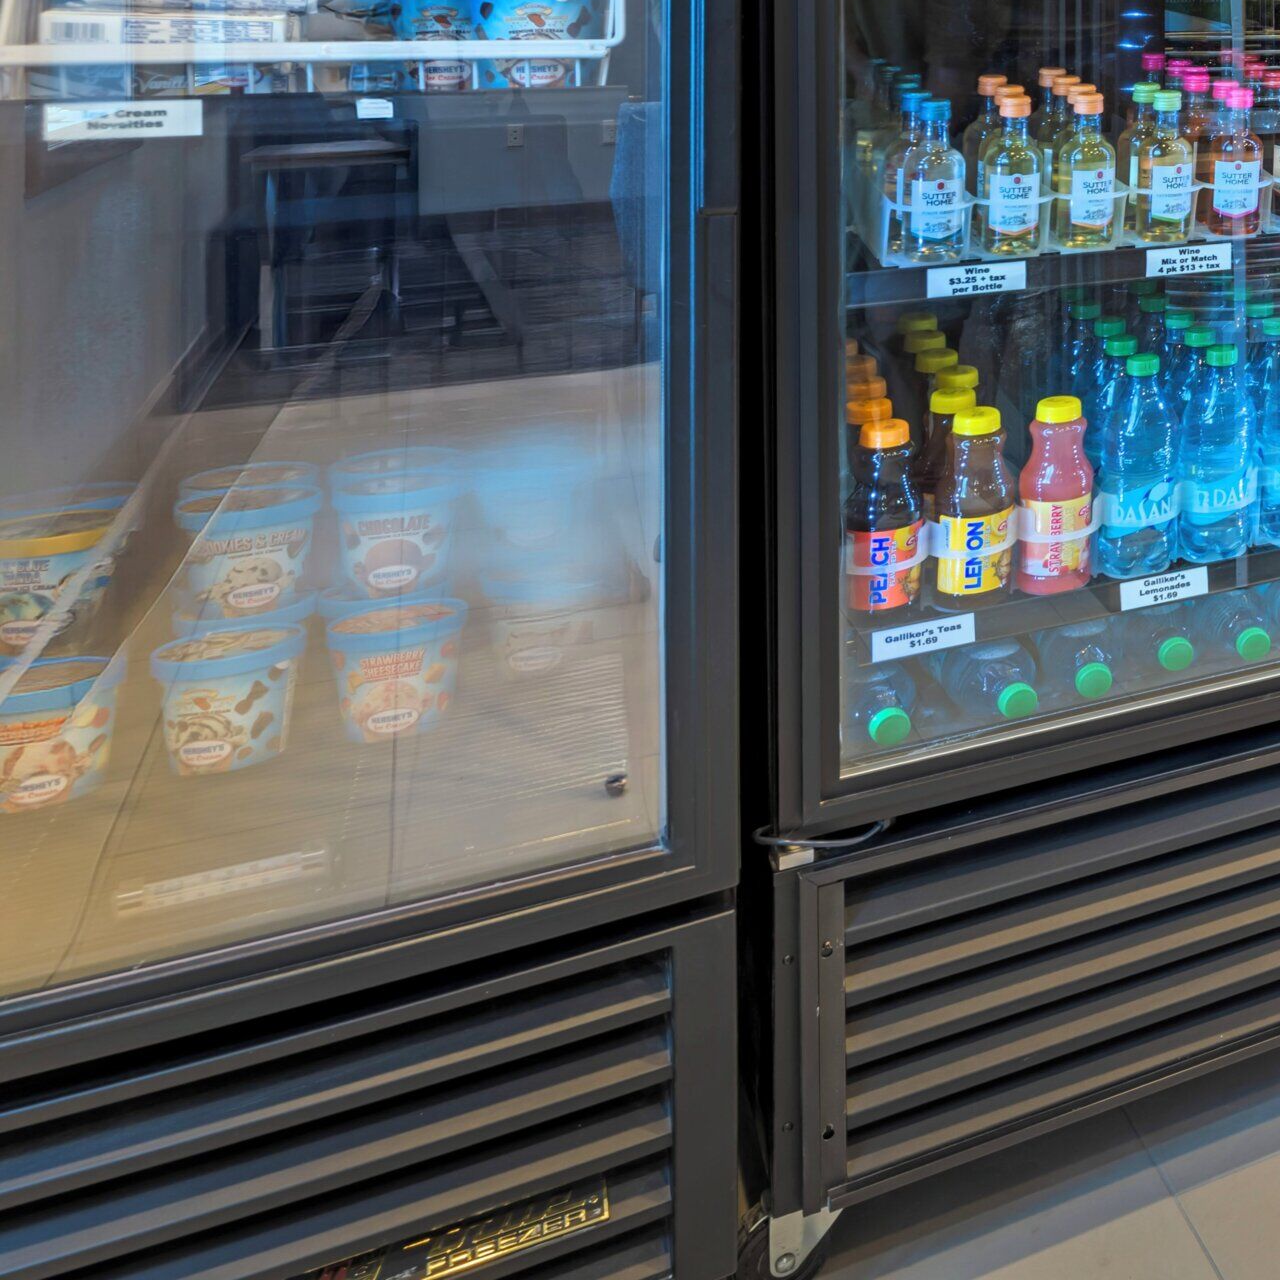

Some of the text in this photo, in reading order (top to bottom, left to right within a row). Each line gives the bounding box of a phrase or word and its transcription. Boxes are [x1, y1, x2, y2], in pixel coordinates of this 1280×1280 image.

[114, 108, 168, 119] Cream
[1221, 172, 1252, 180] SUTTER
[922, 191, 957, 200] SUTTER
[999, 186, 1033, 194] SUTTER
[1178, 248, 1201, 256] Wine
[1161, 257, 1177, 265] Mix
[1191, 253, 1218, 263] Match
[964, 266, 990, 275] Wine
[1158, 262, 1220, 275] 4 pk $13 tax
[949, 273, 1006, 286] $3.25 tax
[952, 282, 1003, 295] per Bottle
[358, 515, 432, 535] CHOCOLATE
[964, 521, 985, 590] LEMON
[372, 568, 413, 580] HERSHEY'S
[1143, 573, 1186, 588] Galliker's
[232, 586, 275, 599] HERSHEY'S
[1139, 582, 1191, 598] Lemonades
[1152, 590, 1178, 602] $1.69
[884, 622, 962, 645] Galliker's Teas
[909, 635, 938, 649] $1.69
[360, 648, 425, 667] STRAWBERRY
[425, 1208, 586, 1276] FREEZER
